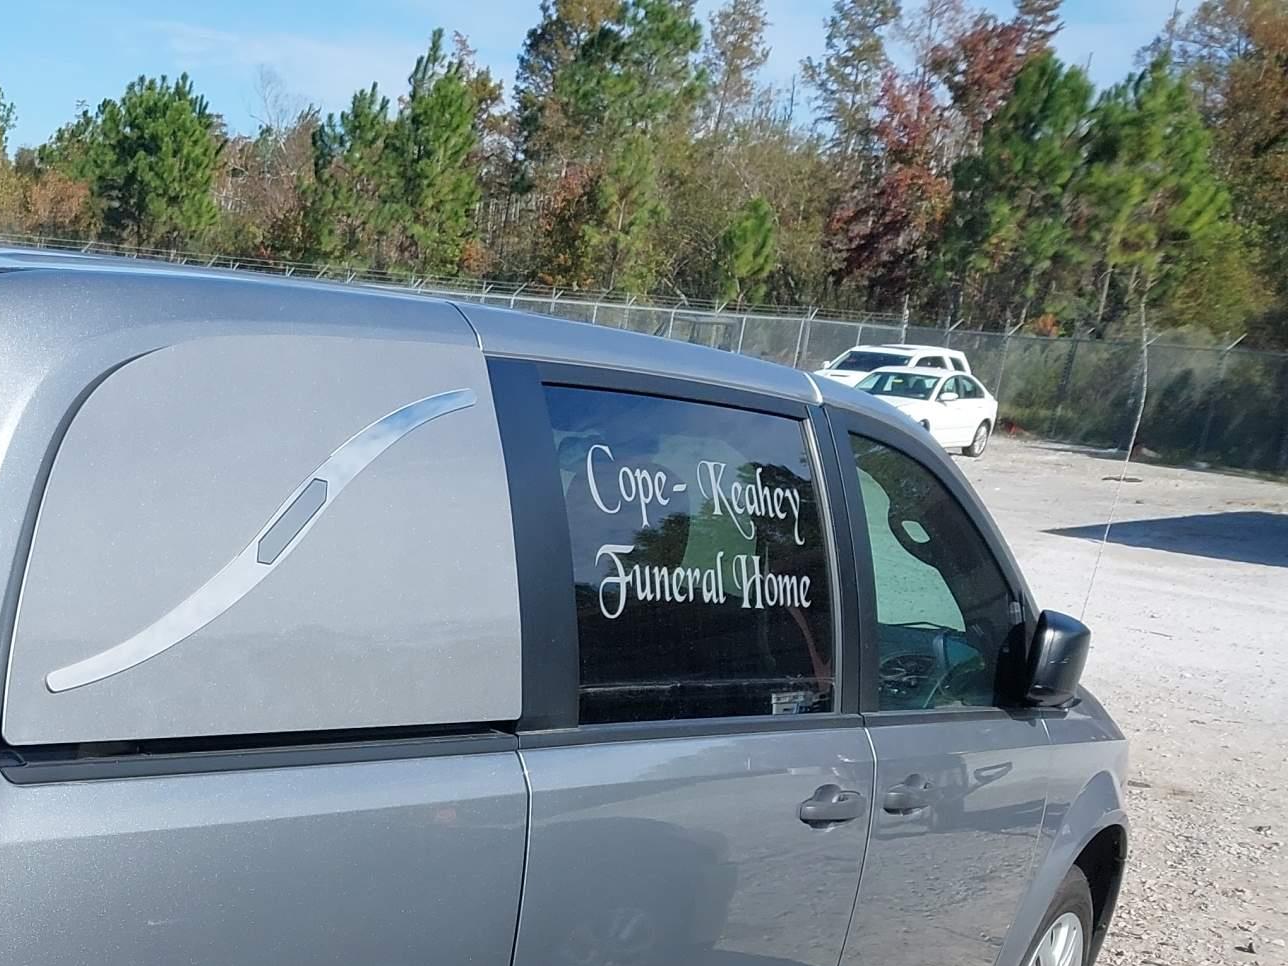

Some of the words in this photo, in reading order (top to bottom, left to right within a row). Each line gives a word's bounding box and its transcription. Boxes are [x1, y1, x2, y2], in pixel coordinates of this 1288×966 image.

[586, 444, 687, 529] Cope-
[594, 544, 727, 619] Funeral
[732, 554, 812, 609] Home
